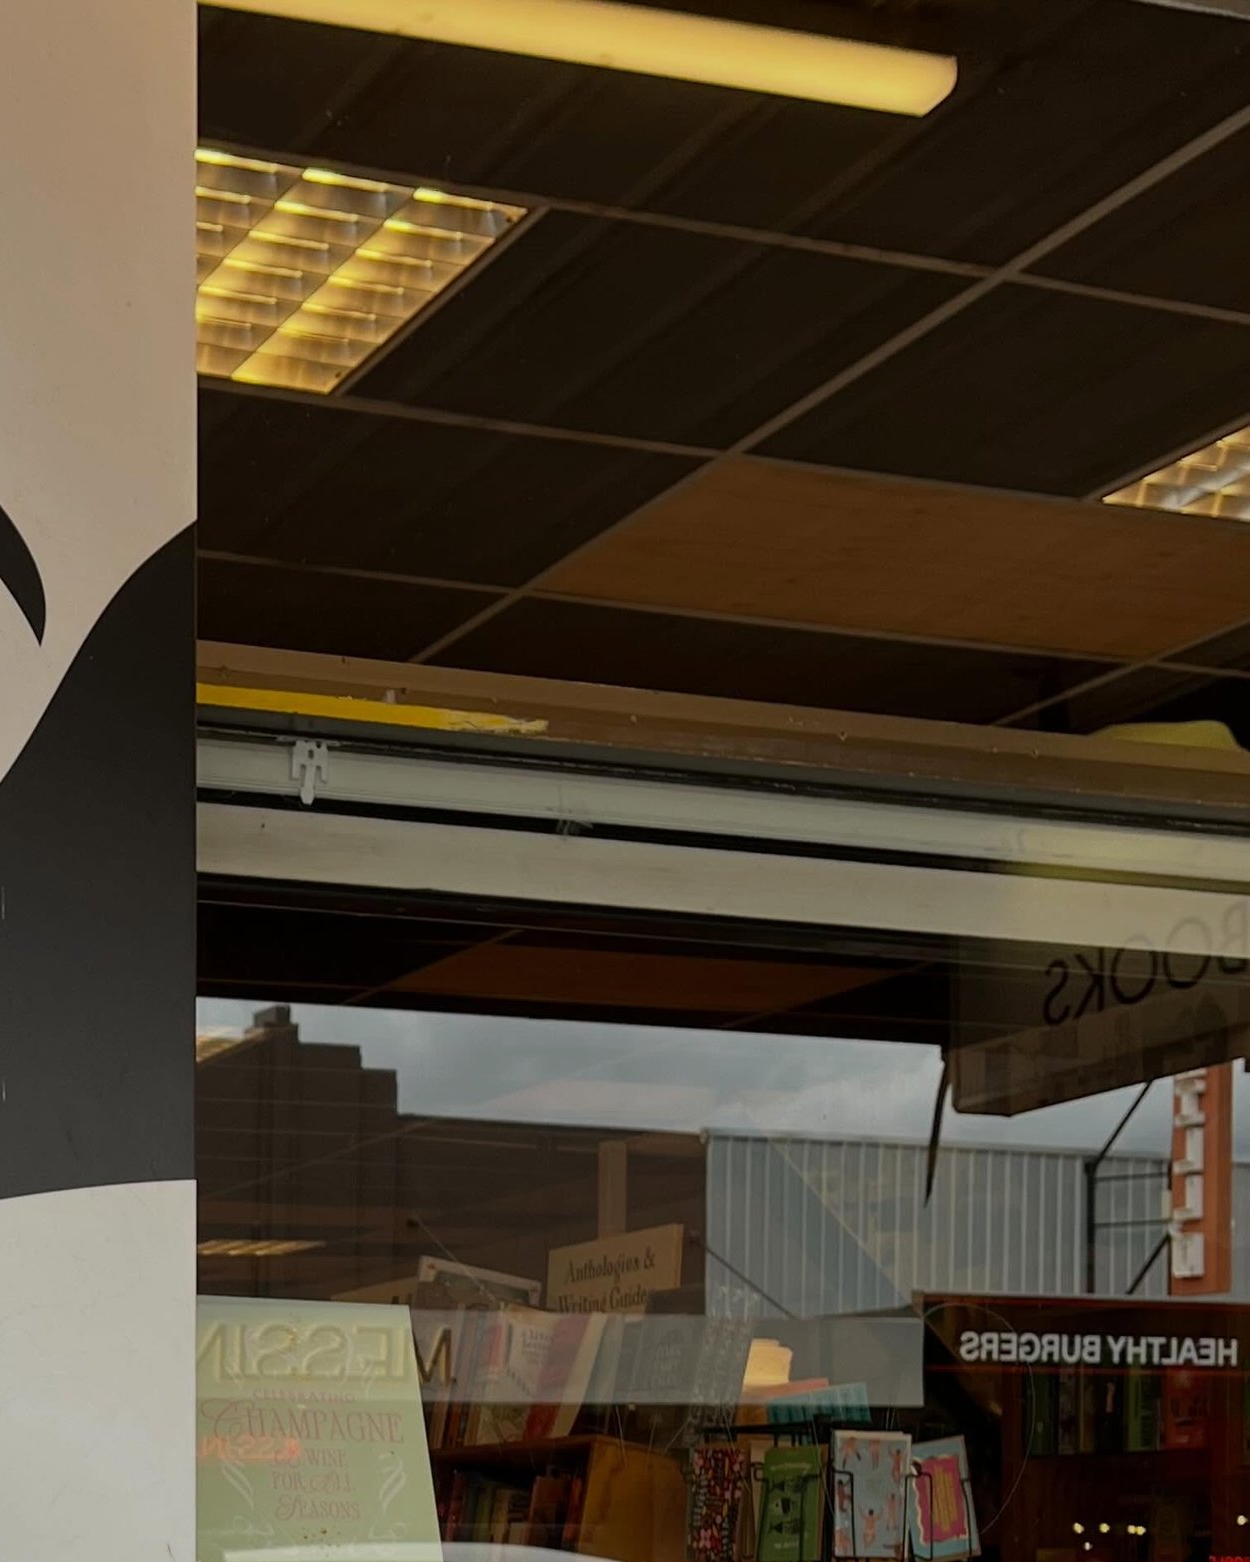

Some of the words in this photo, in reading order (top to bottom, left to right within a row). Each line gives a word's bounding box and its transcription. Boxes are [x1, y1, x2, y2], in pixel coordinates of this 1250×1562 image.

[565, 1253, 639, 1284] Anthologies
[610, 1284, 652, 1312] Guide
[200, 1396, 405, 1444] CHAMPAGNE
[275, 1495, 361, 1521] SEASONS
